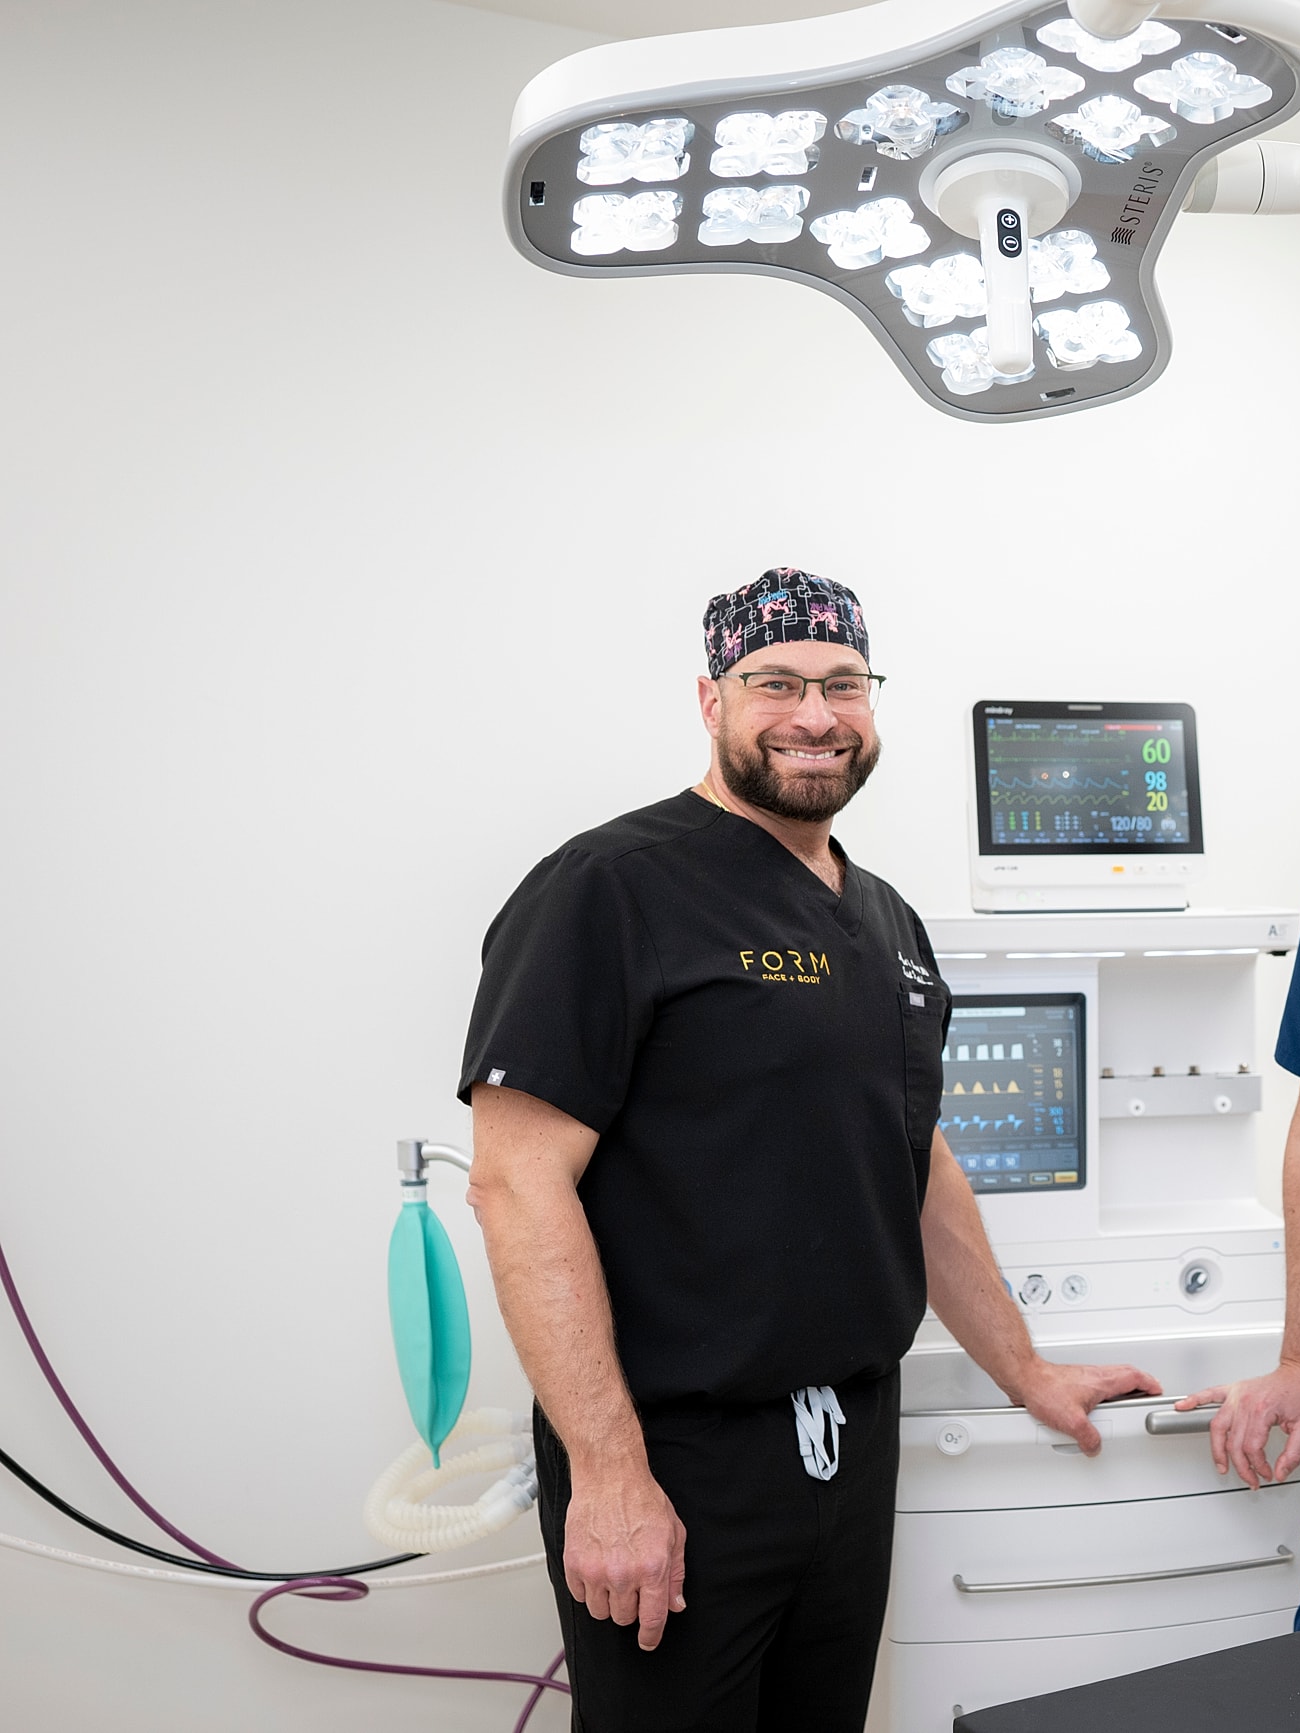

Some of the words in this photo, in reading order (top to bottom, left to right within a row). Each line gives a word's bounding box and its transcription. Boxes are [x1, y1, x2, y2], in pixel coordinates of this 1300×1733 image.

[1142, 738, 1171, 764] 60
[1144, 770, 1168, 791] 98
[1146, 791, 1168, 812] 20
[1110, 815, 1152, 831] 120/80
[740, 950, 831, 976] FORM
[762, 973, 788, 982] FACE
[797, 974, 820, 985] BODY
